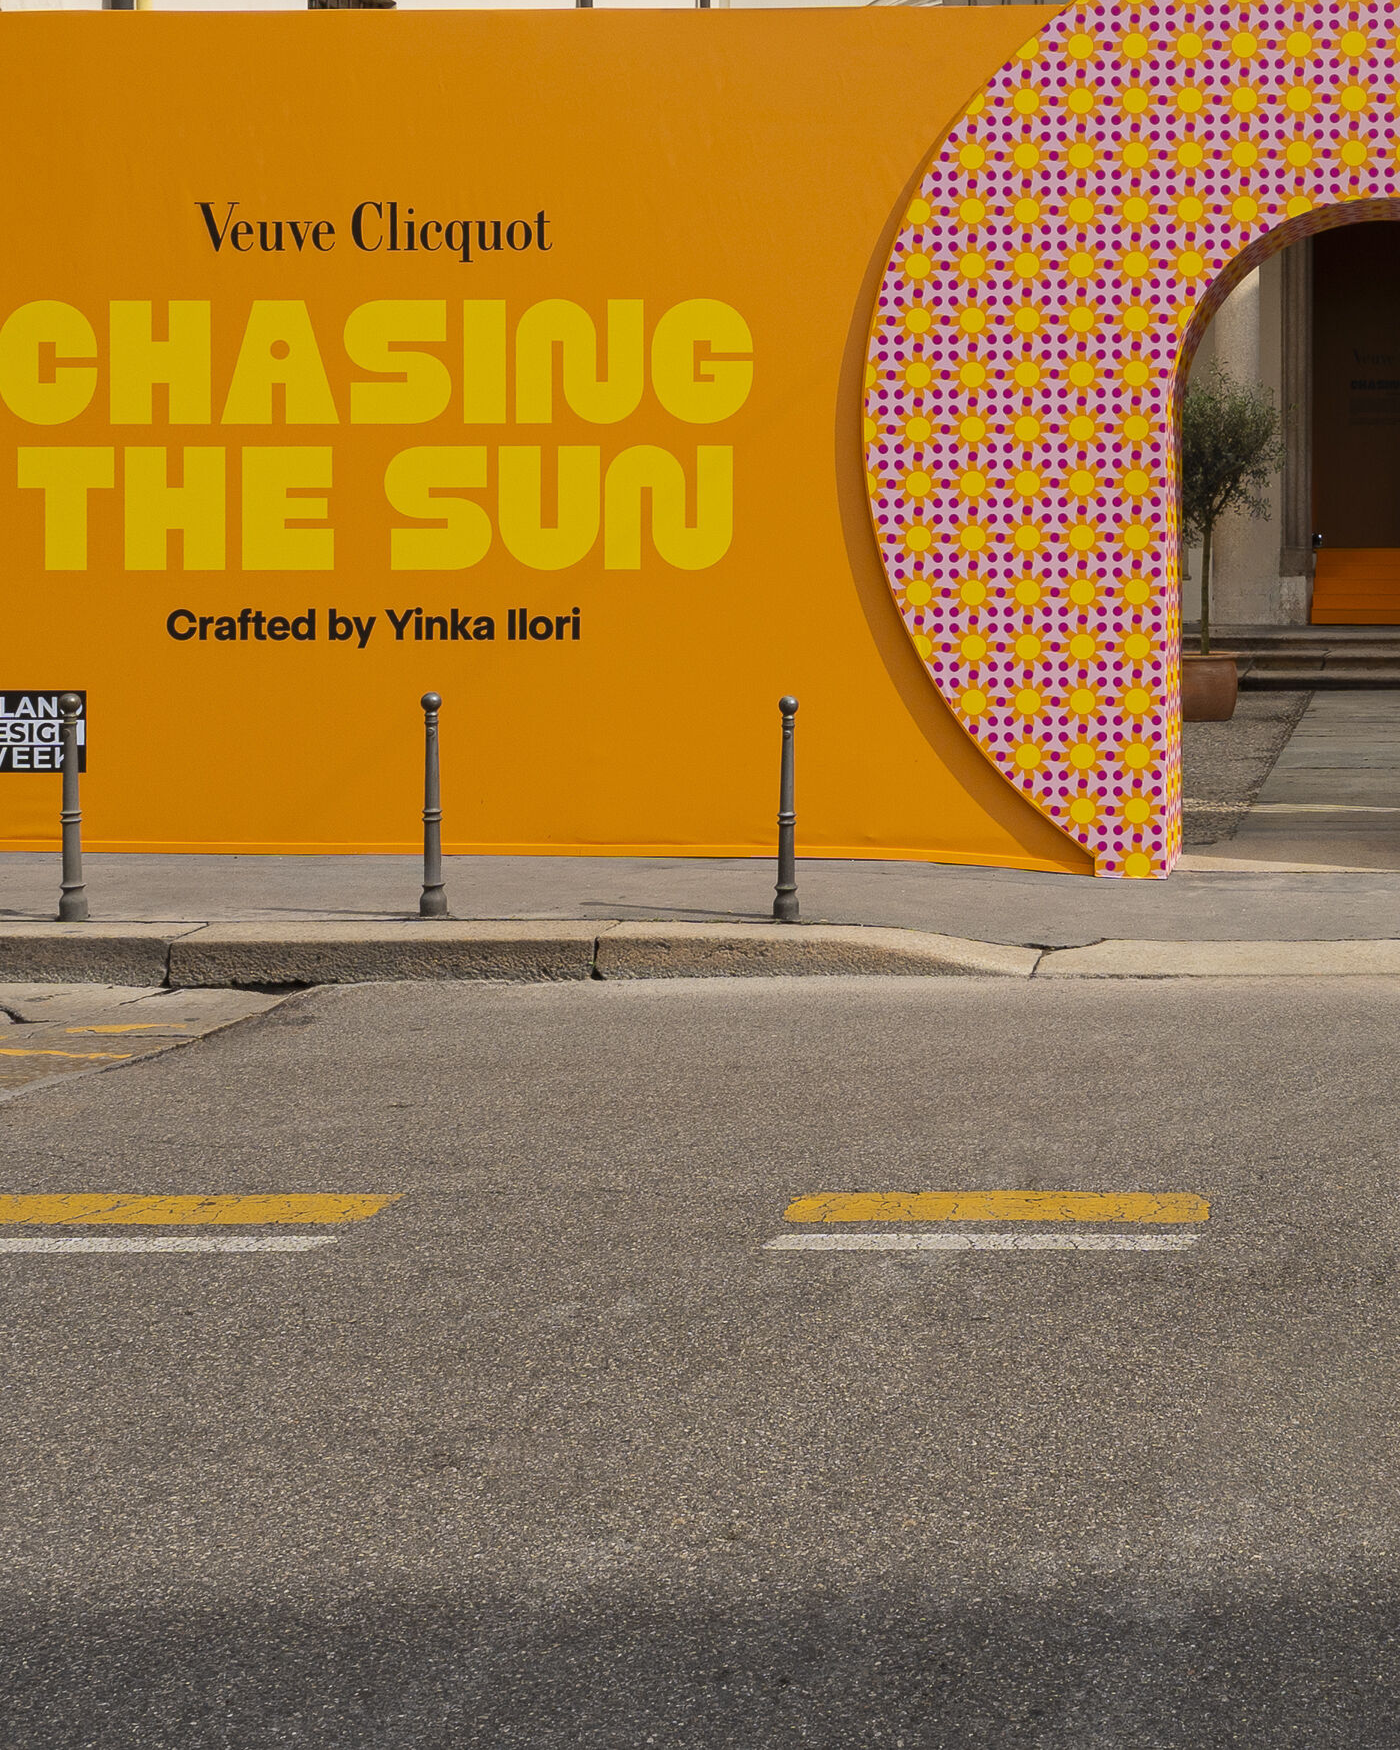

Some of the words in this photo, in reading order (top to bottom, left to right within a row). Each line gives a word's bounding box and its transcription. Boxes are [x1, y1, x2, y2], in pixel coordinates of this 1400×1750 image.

[194, 201, 336, 252] Veuve
[351, 201, 553, 263] Clicquot
[0, 299, 753, 425] CHASING
[18, 446, 334, 570] THE
[384, 445, 733, 570] SUN
[166, 608, 316, 641] Crafted
[329, 608, 376, 648] by
[385, 607, 495, 641] Yinka
[507, 607, 581, 641] Ilori
